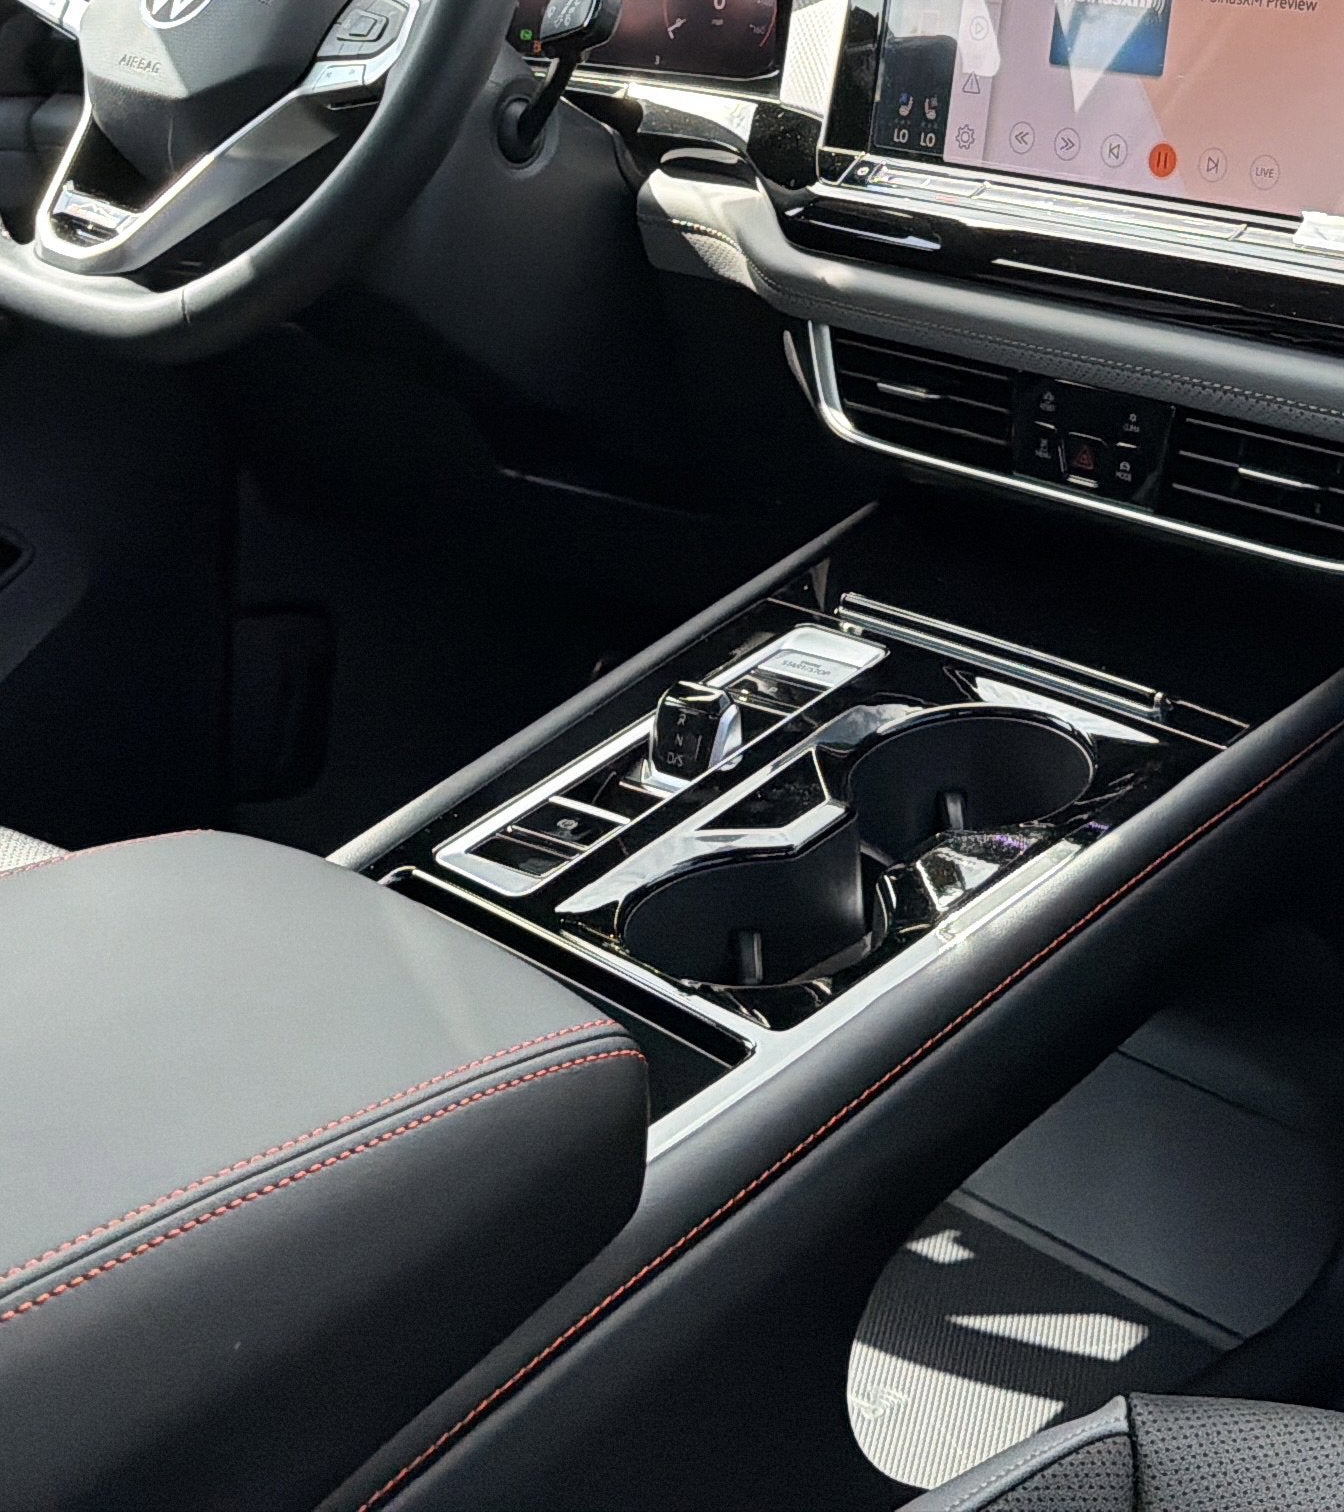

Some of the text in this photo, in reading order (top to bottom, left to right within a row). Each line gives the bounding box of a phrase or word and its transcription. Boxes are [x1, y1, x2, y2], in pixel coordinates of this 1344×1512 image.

[118, 54, 162, 73] AIRBAG
[893, 128, 936, 147] LO LO
[1255, 167, 1275, 178] LIVE
[677, 713, 687, 726] R
[675, 733, 684, 747] N
[667, 752, 684, 767] D/S
